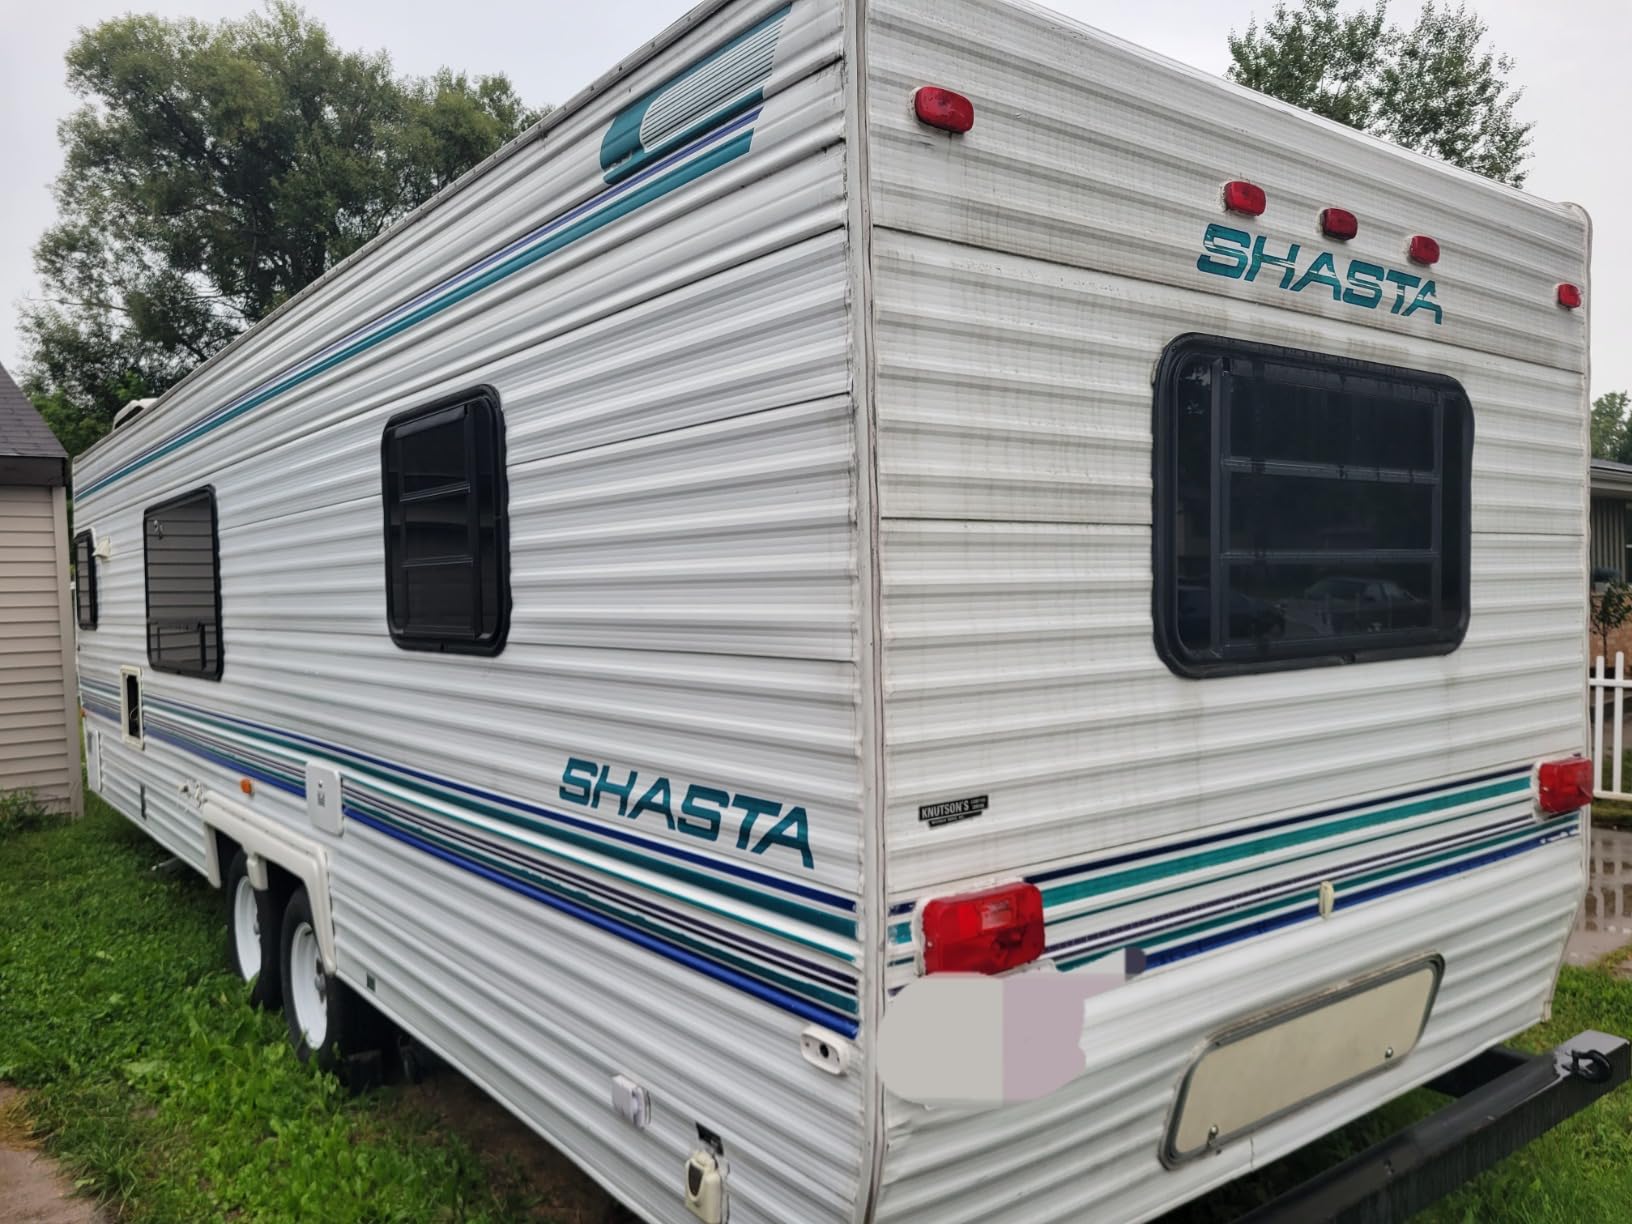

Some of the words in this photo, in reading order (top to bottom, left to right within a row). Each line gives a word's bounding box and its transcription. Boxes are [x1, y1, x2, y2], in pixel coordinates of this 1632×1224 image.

[1197, 223, 1443, 325] SHASTA
[559, 757, 815, 869] SHASTA
[921, 800, 970, 819] KNUTSON'S
